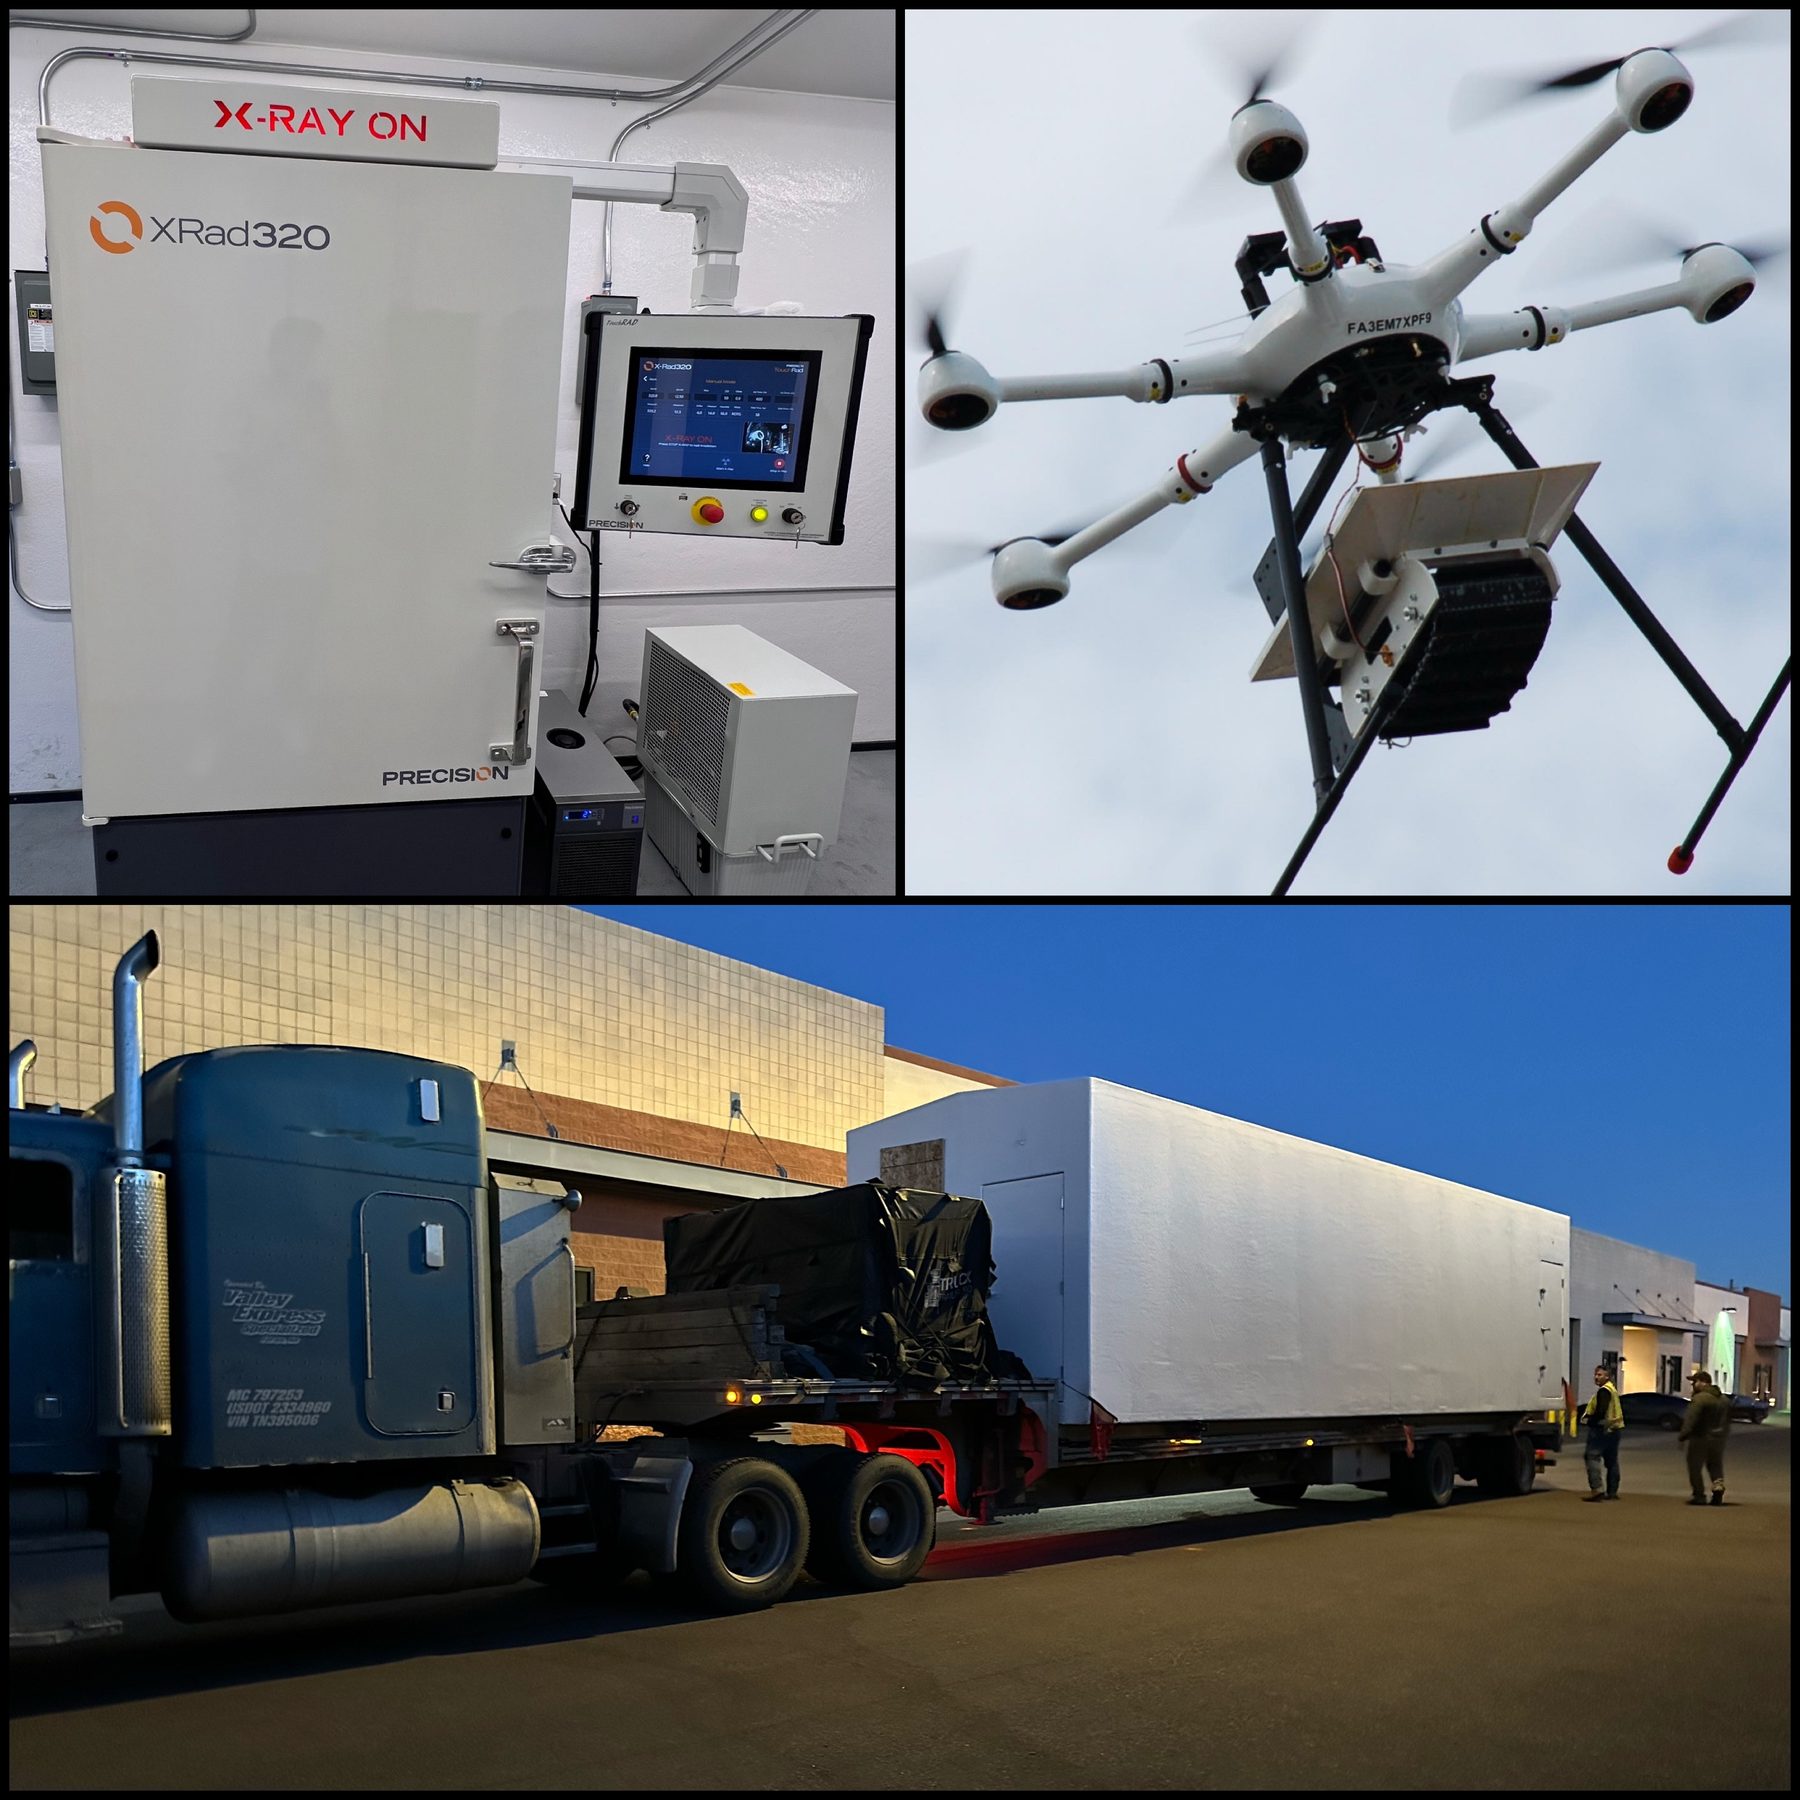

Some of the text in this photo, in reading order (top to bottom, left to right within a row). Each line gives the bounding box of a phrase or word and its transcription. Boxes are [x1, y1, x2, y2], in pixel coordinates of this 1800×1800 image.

[213, 99, 428, 142] X-RAY ON
[150, 215, 331, 251] XRad320
[1347, 312, 1432, 334] FA3EM7XPF9
[654, 363, 692, 371] X-Rad320
[665, 434, 712, 444] X-RAY ON
[382, 765, 509, 786] PRECISION
[223, 1289, 294, 1309] Valley
[232, 1307, 326, 1324] Express
[227, 1389, 304, 1401] MC 797253
[227, 1401, 269, 1414] USDOT
[227, 1414, 249, 1427] VIN
